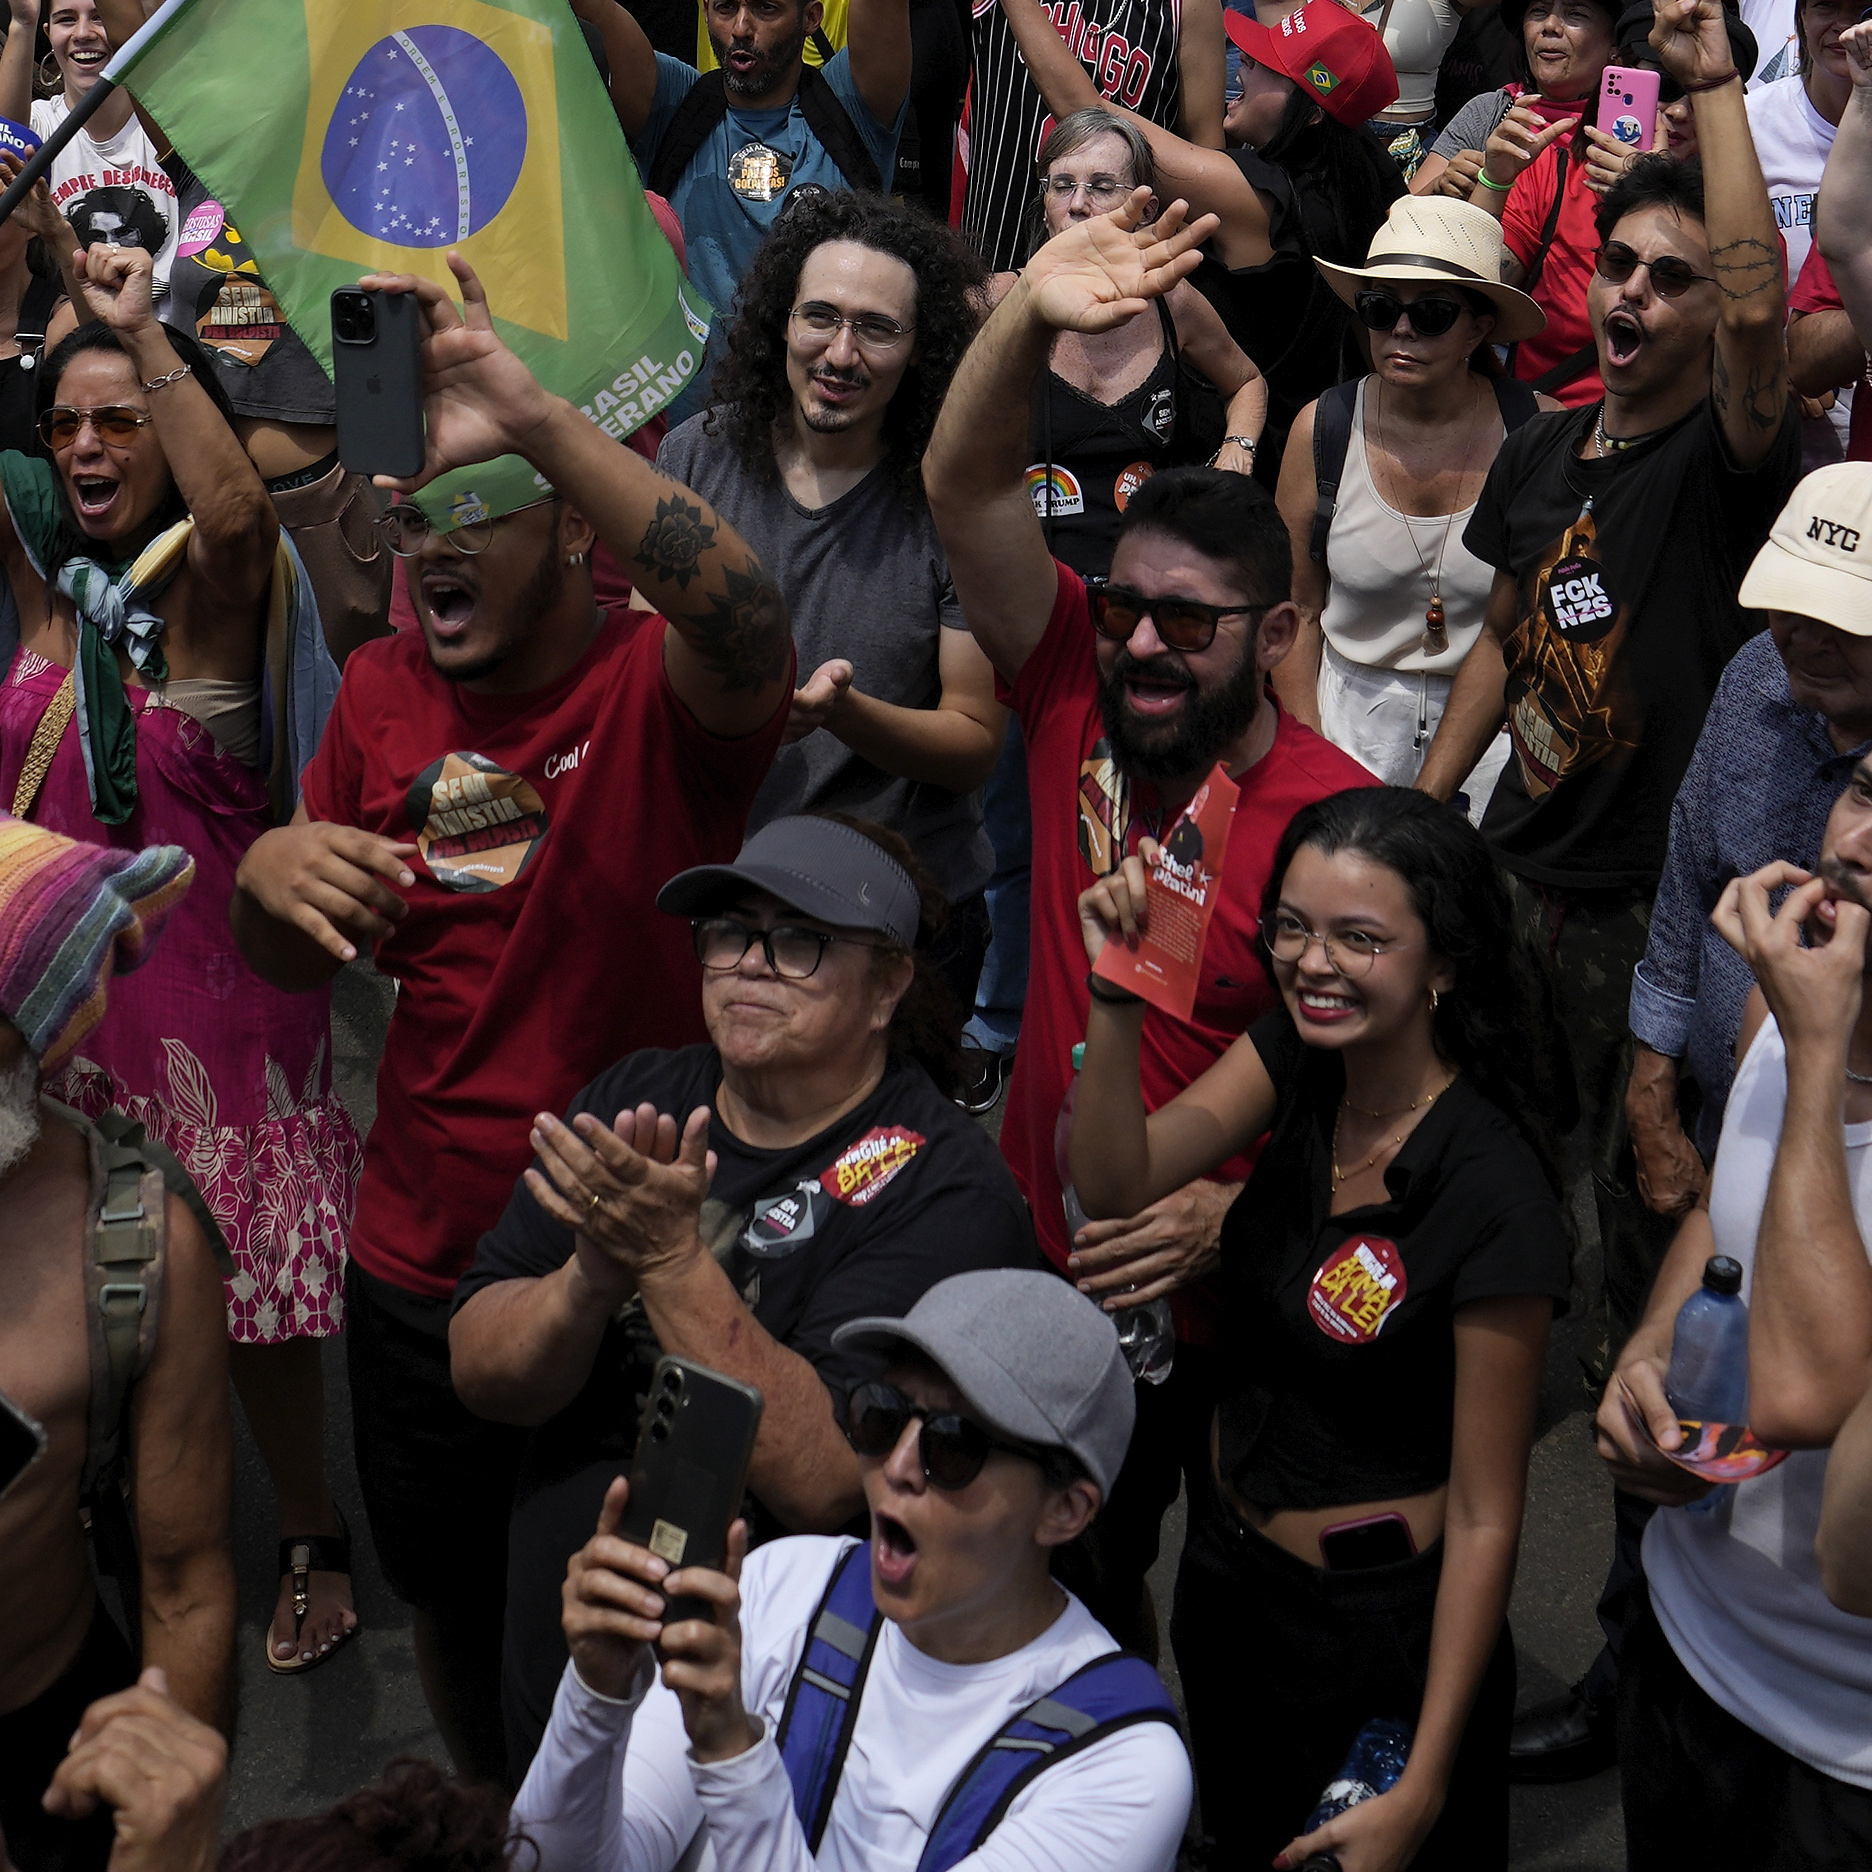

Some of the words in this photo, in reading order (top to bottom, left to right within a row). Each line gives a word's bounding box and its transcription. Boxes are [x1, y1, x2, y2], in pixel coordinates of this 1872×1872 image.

[401, 37, 440, 85] ORDEM
[441, 112, 472, 236] PROGRESSO
[218, 287, 260, 307] SEM
[210, 306, 274, 326] ANISTIA
[596, 349, 697, 441] ERANO
[1807, 516, 1861, 553] NYC
[1550, 574, 1606, 608] FCK
[1555, 595, 1613, 630] NZS
[431, 772, 490, 811] SEM
[428, 796, 525, 837] ANISTIA
